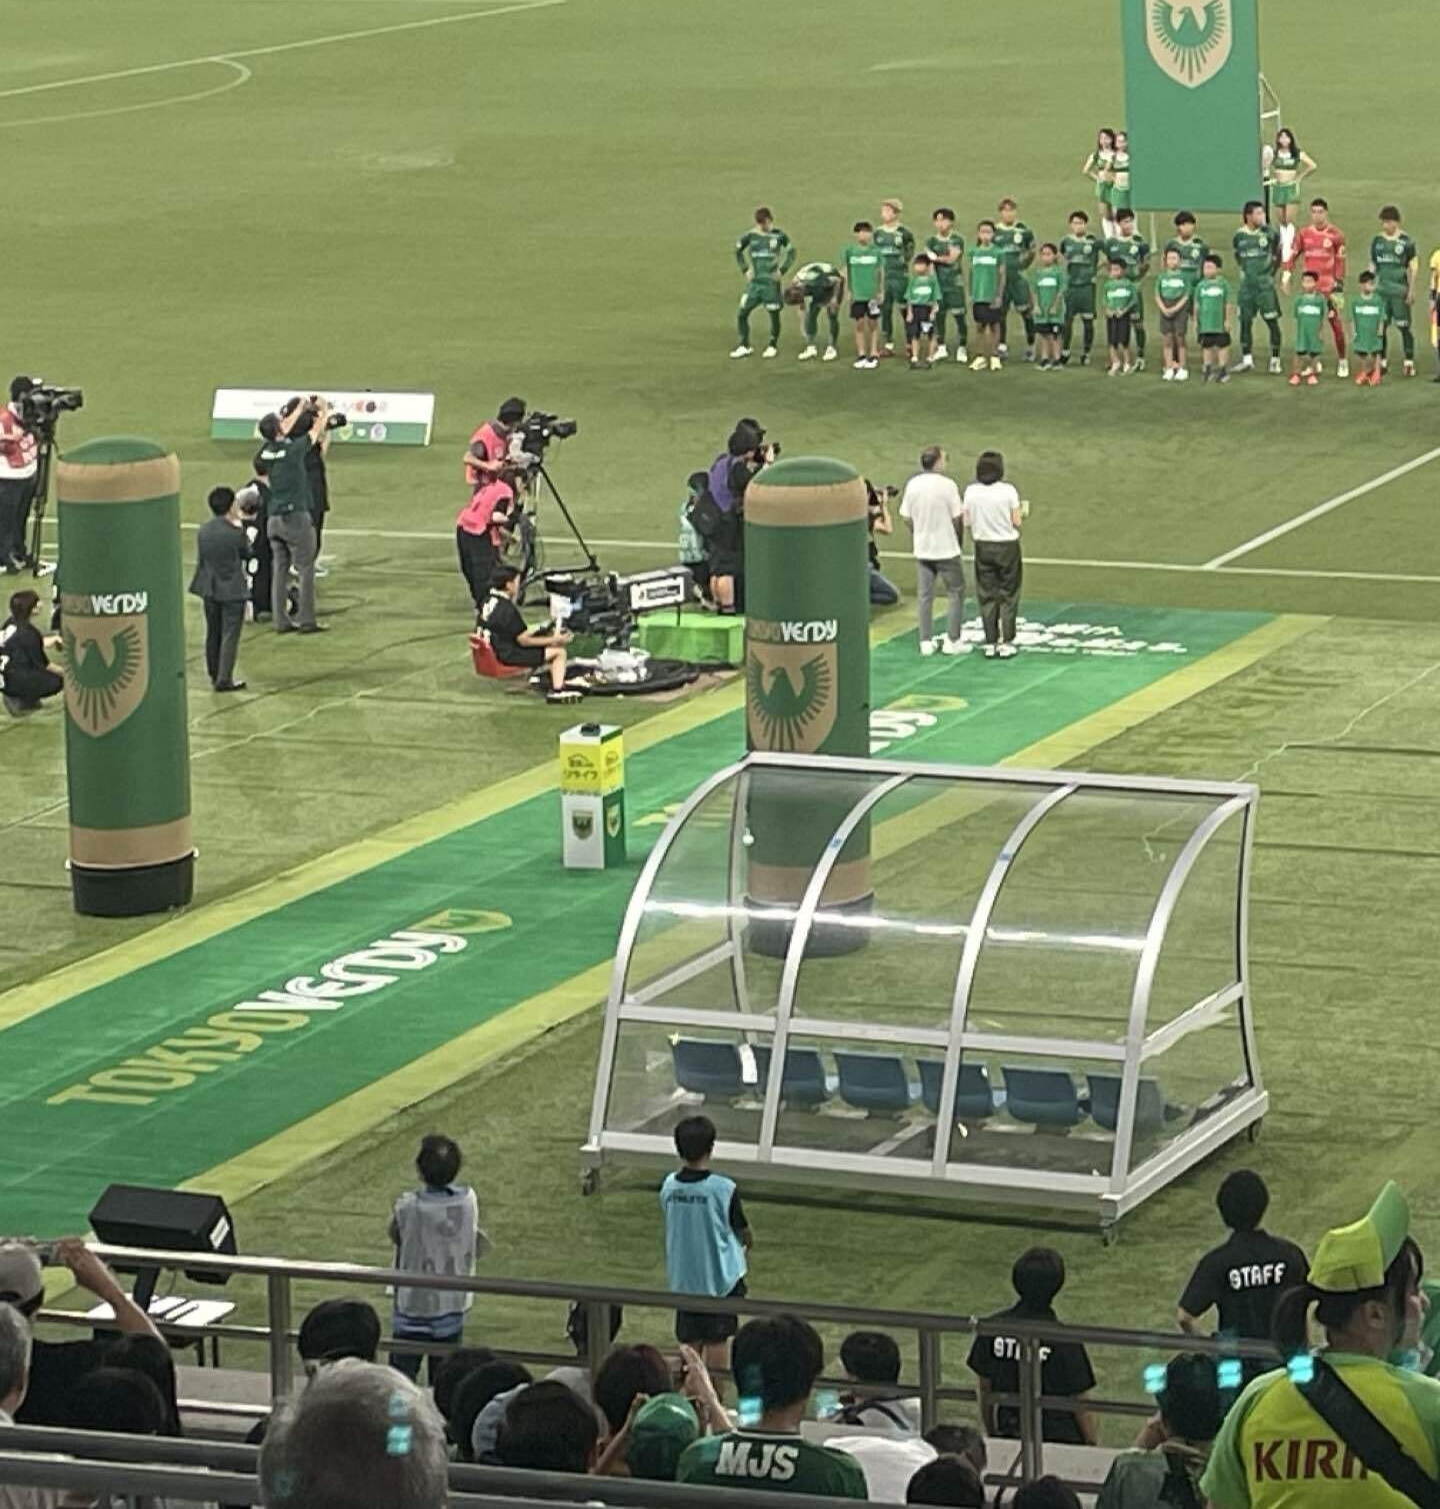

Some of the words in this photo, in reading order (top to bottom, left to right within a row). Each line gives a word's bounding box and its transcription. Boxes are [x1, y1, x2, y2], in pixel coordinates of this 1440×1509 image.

[1228, 1262, 1286, 1291] STAFF
[993, 1336, 1051, 1361] STF
[715, 1441, 800, 1481] MJS
